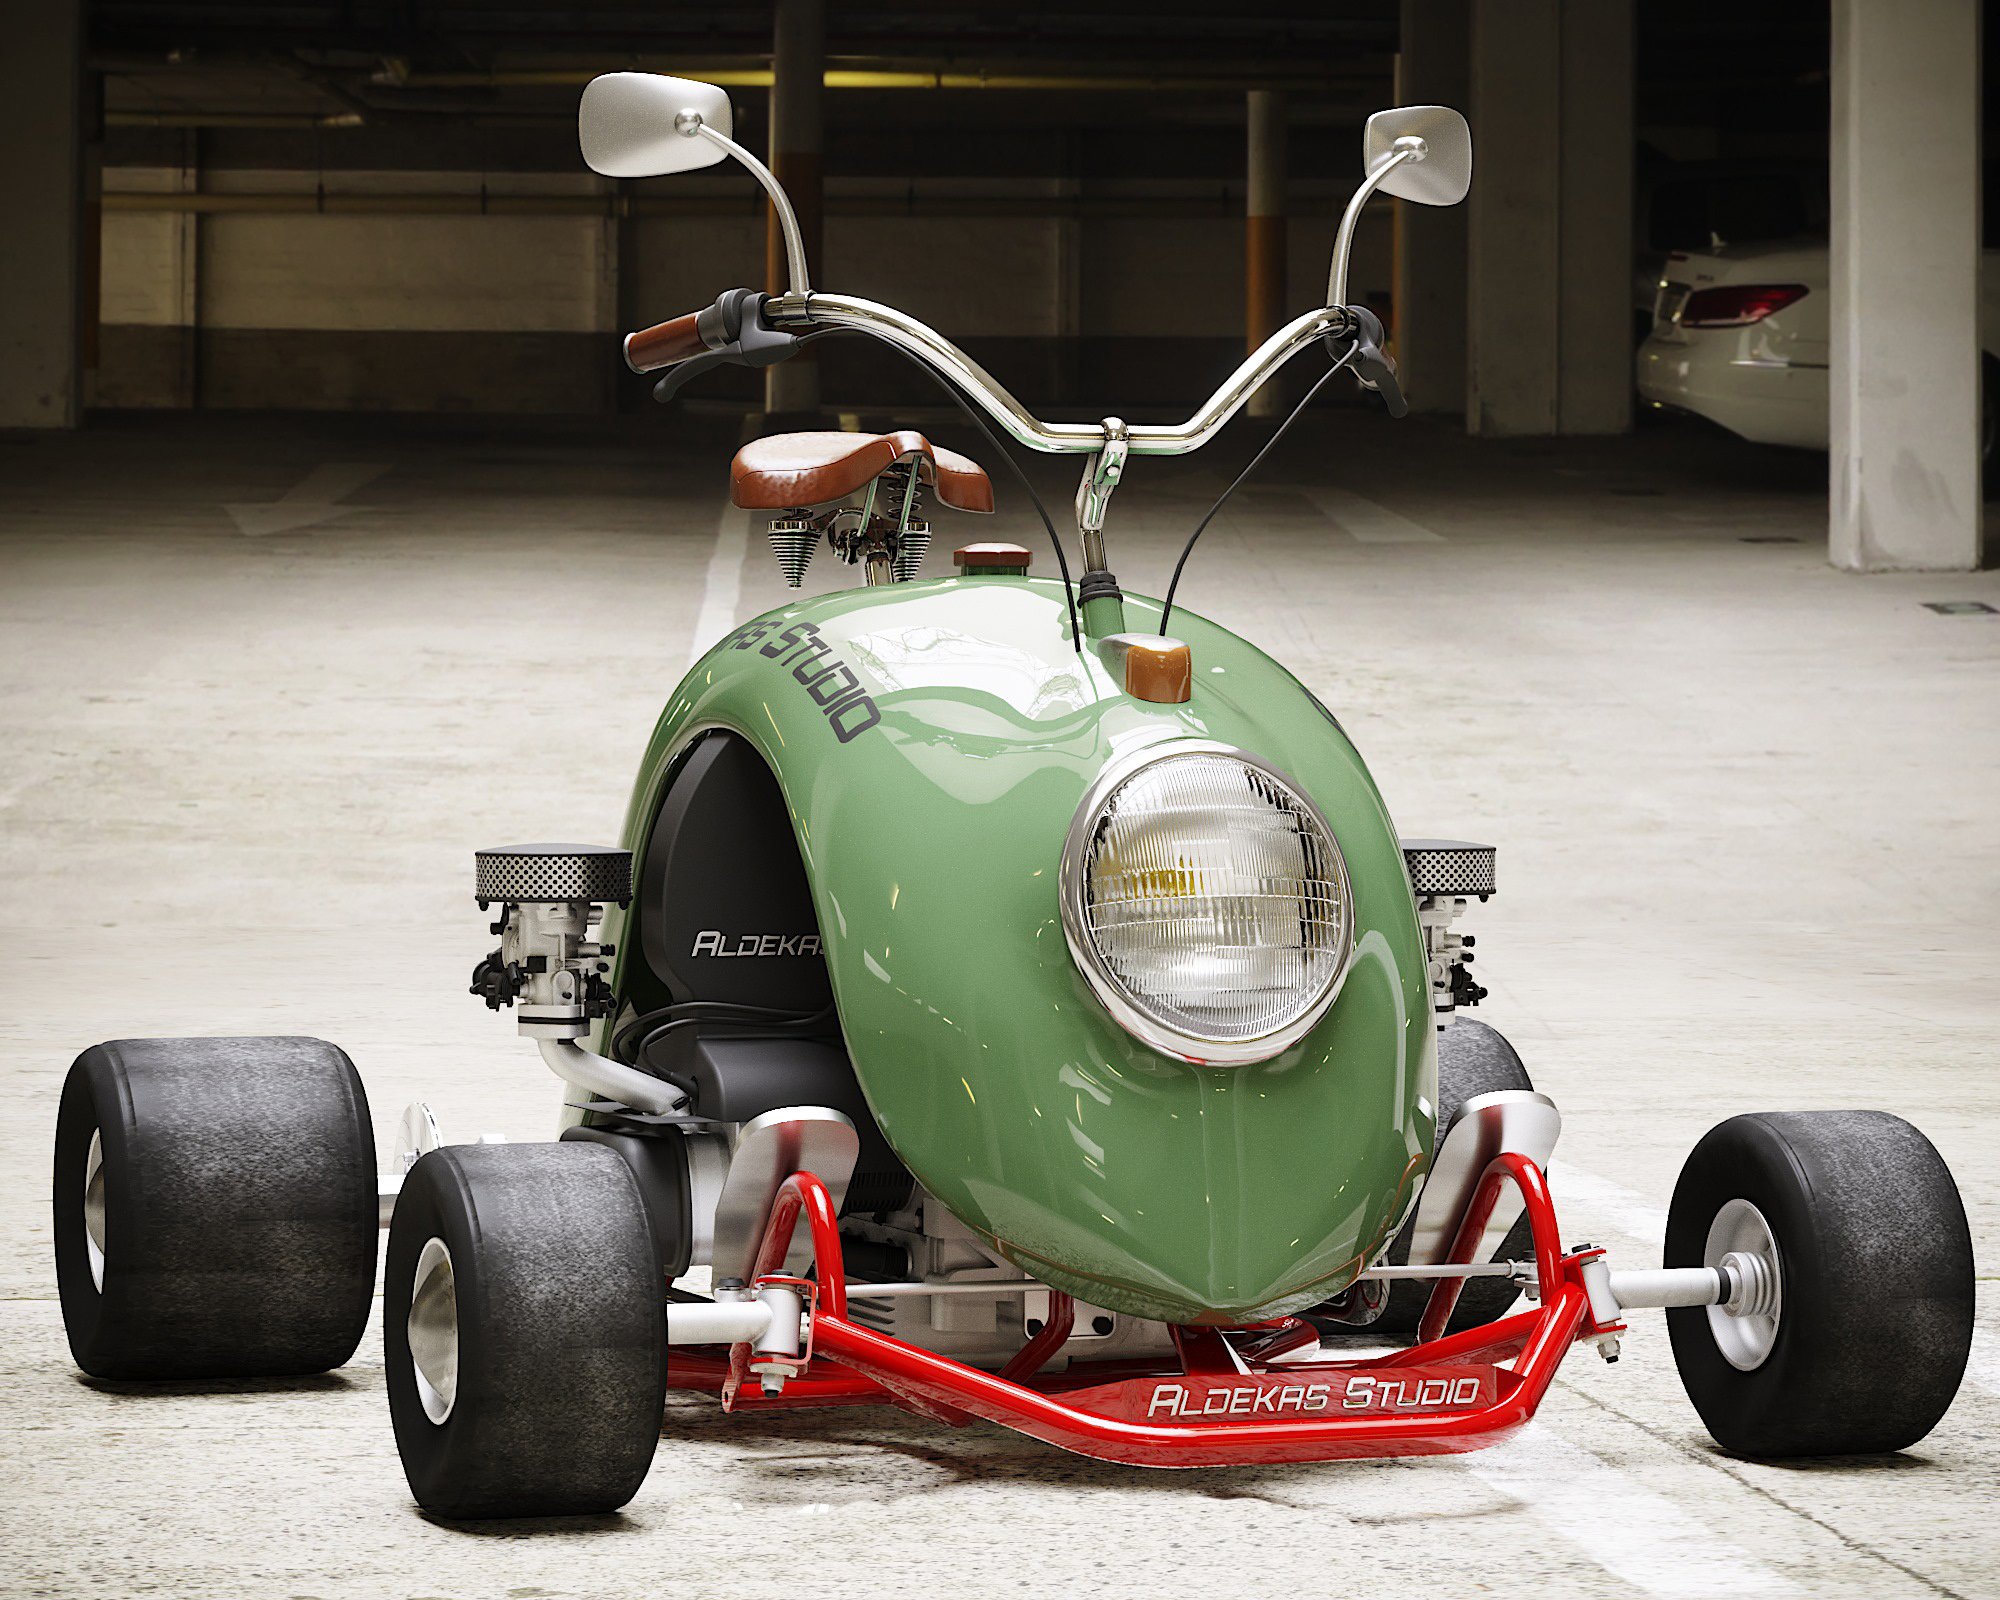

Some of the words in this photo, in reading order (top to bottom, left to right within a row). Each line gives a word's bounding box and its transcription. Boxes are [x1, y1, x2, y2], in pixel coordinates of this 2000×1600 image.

[759, 622, 882, 744] STUDIO
[691, 930, 825, 957] ALDEKA
[1147, 1384, 1330, 1417] ALDEKAS
[1343, 1376, 1480, 1408] STUDIO
